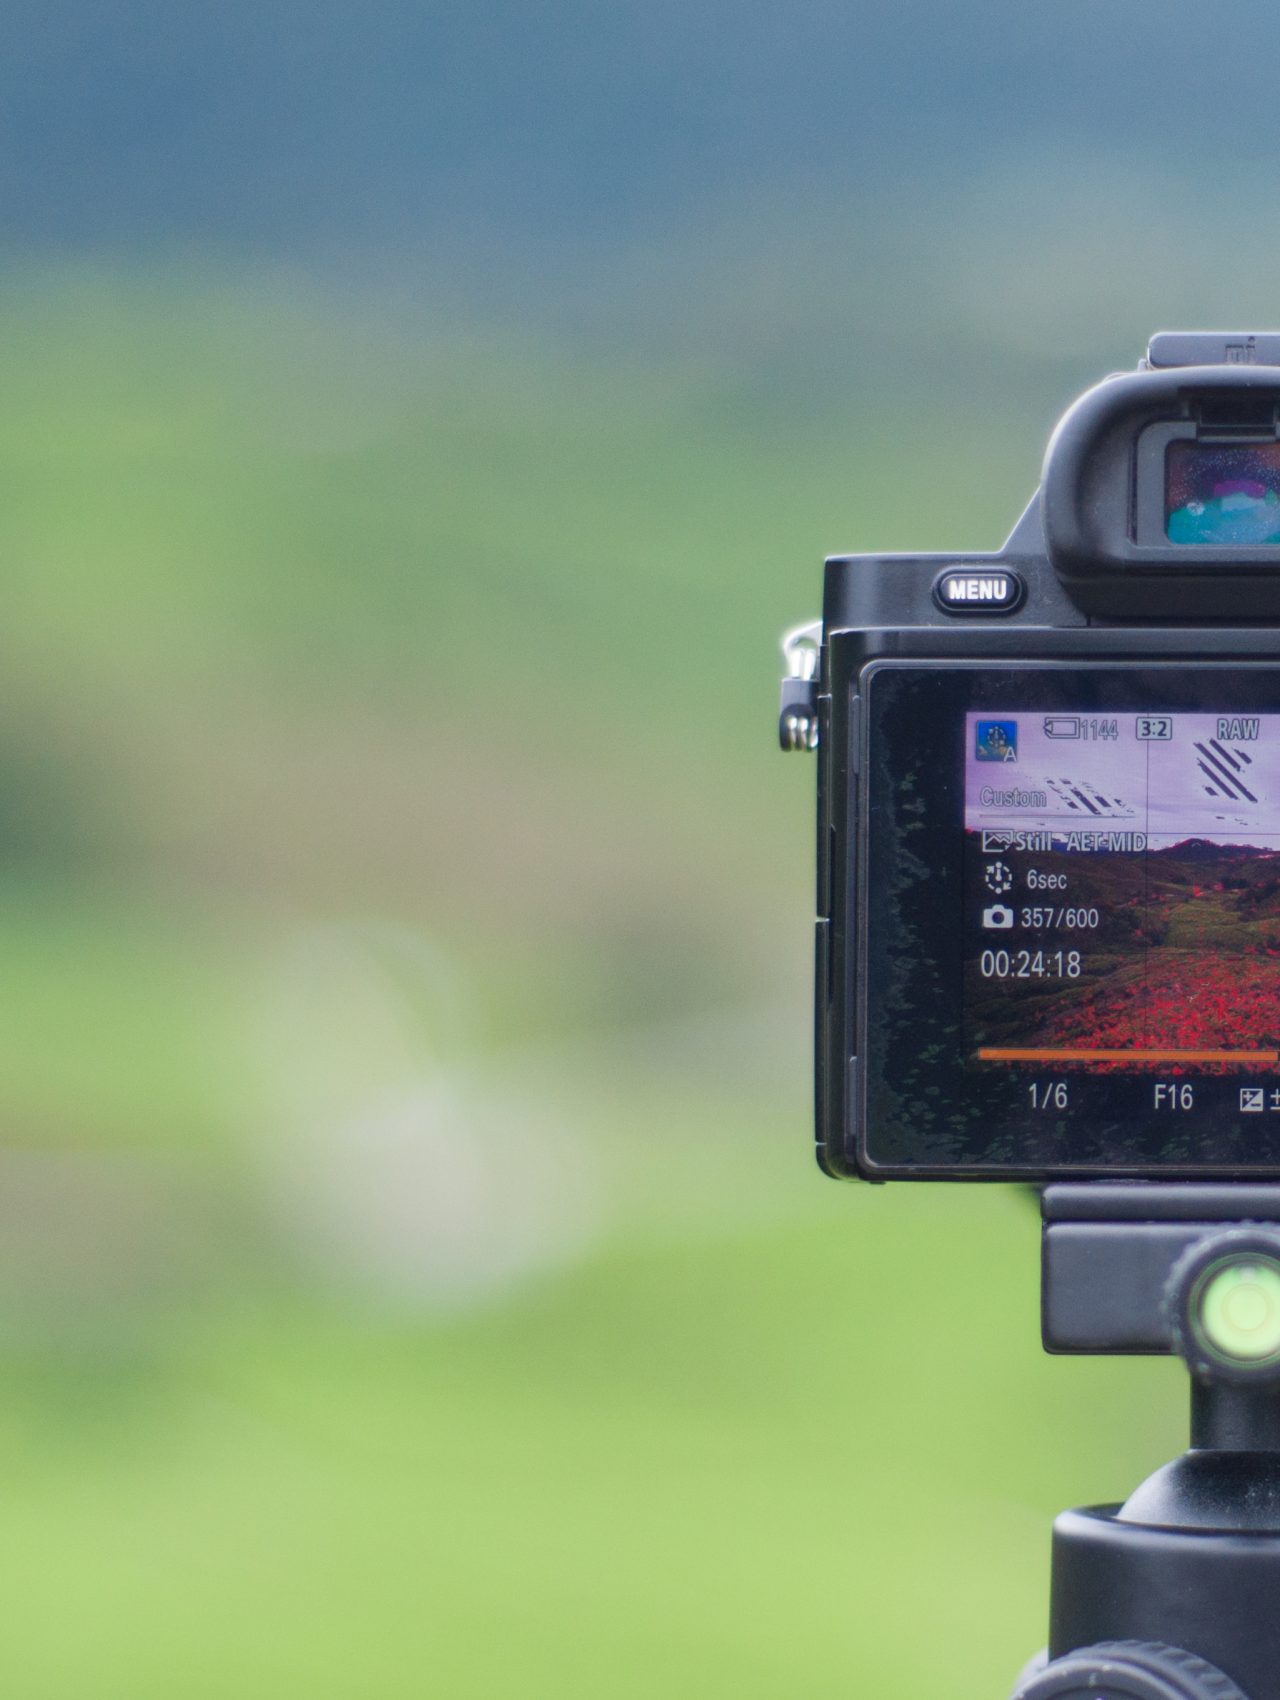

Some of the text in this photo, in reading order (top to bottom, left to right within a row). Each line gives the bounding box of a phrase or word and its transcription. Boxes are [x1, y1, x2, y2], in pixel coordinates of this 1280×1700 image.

[948, 579, 1007, 600] MENU
[1080, 719, 1119, 741] 1144
[1141, 720, 1168, 737] 3:2
[1216, 718, 1260, 740] RAW
[1003, 746, 1017, 762] A
[980, 786, 1047, 808] Custom
[1014, 832, 1148, 852] Still AET-MID
[1026, 869, 1068, 890] 6sec
[1021, 907, 1099, 928] 357/600
[980, 950, 1081, 978] 00:24:18
[1028, 1082, 1068, 1109] 1/6
[1154, 1084, 1194, 1110] F16
